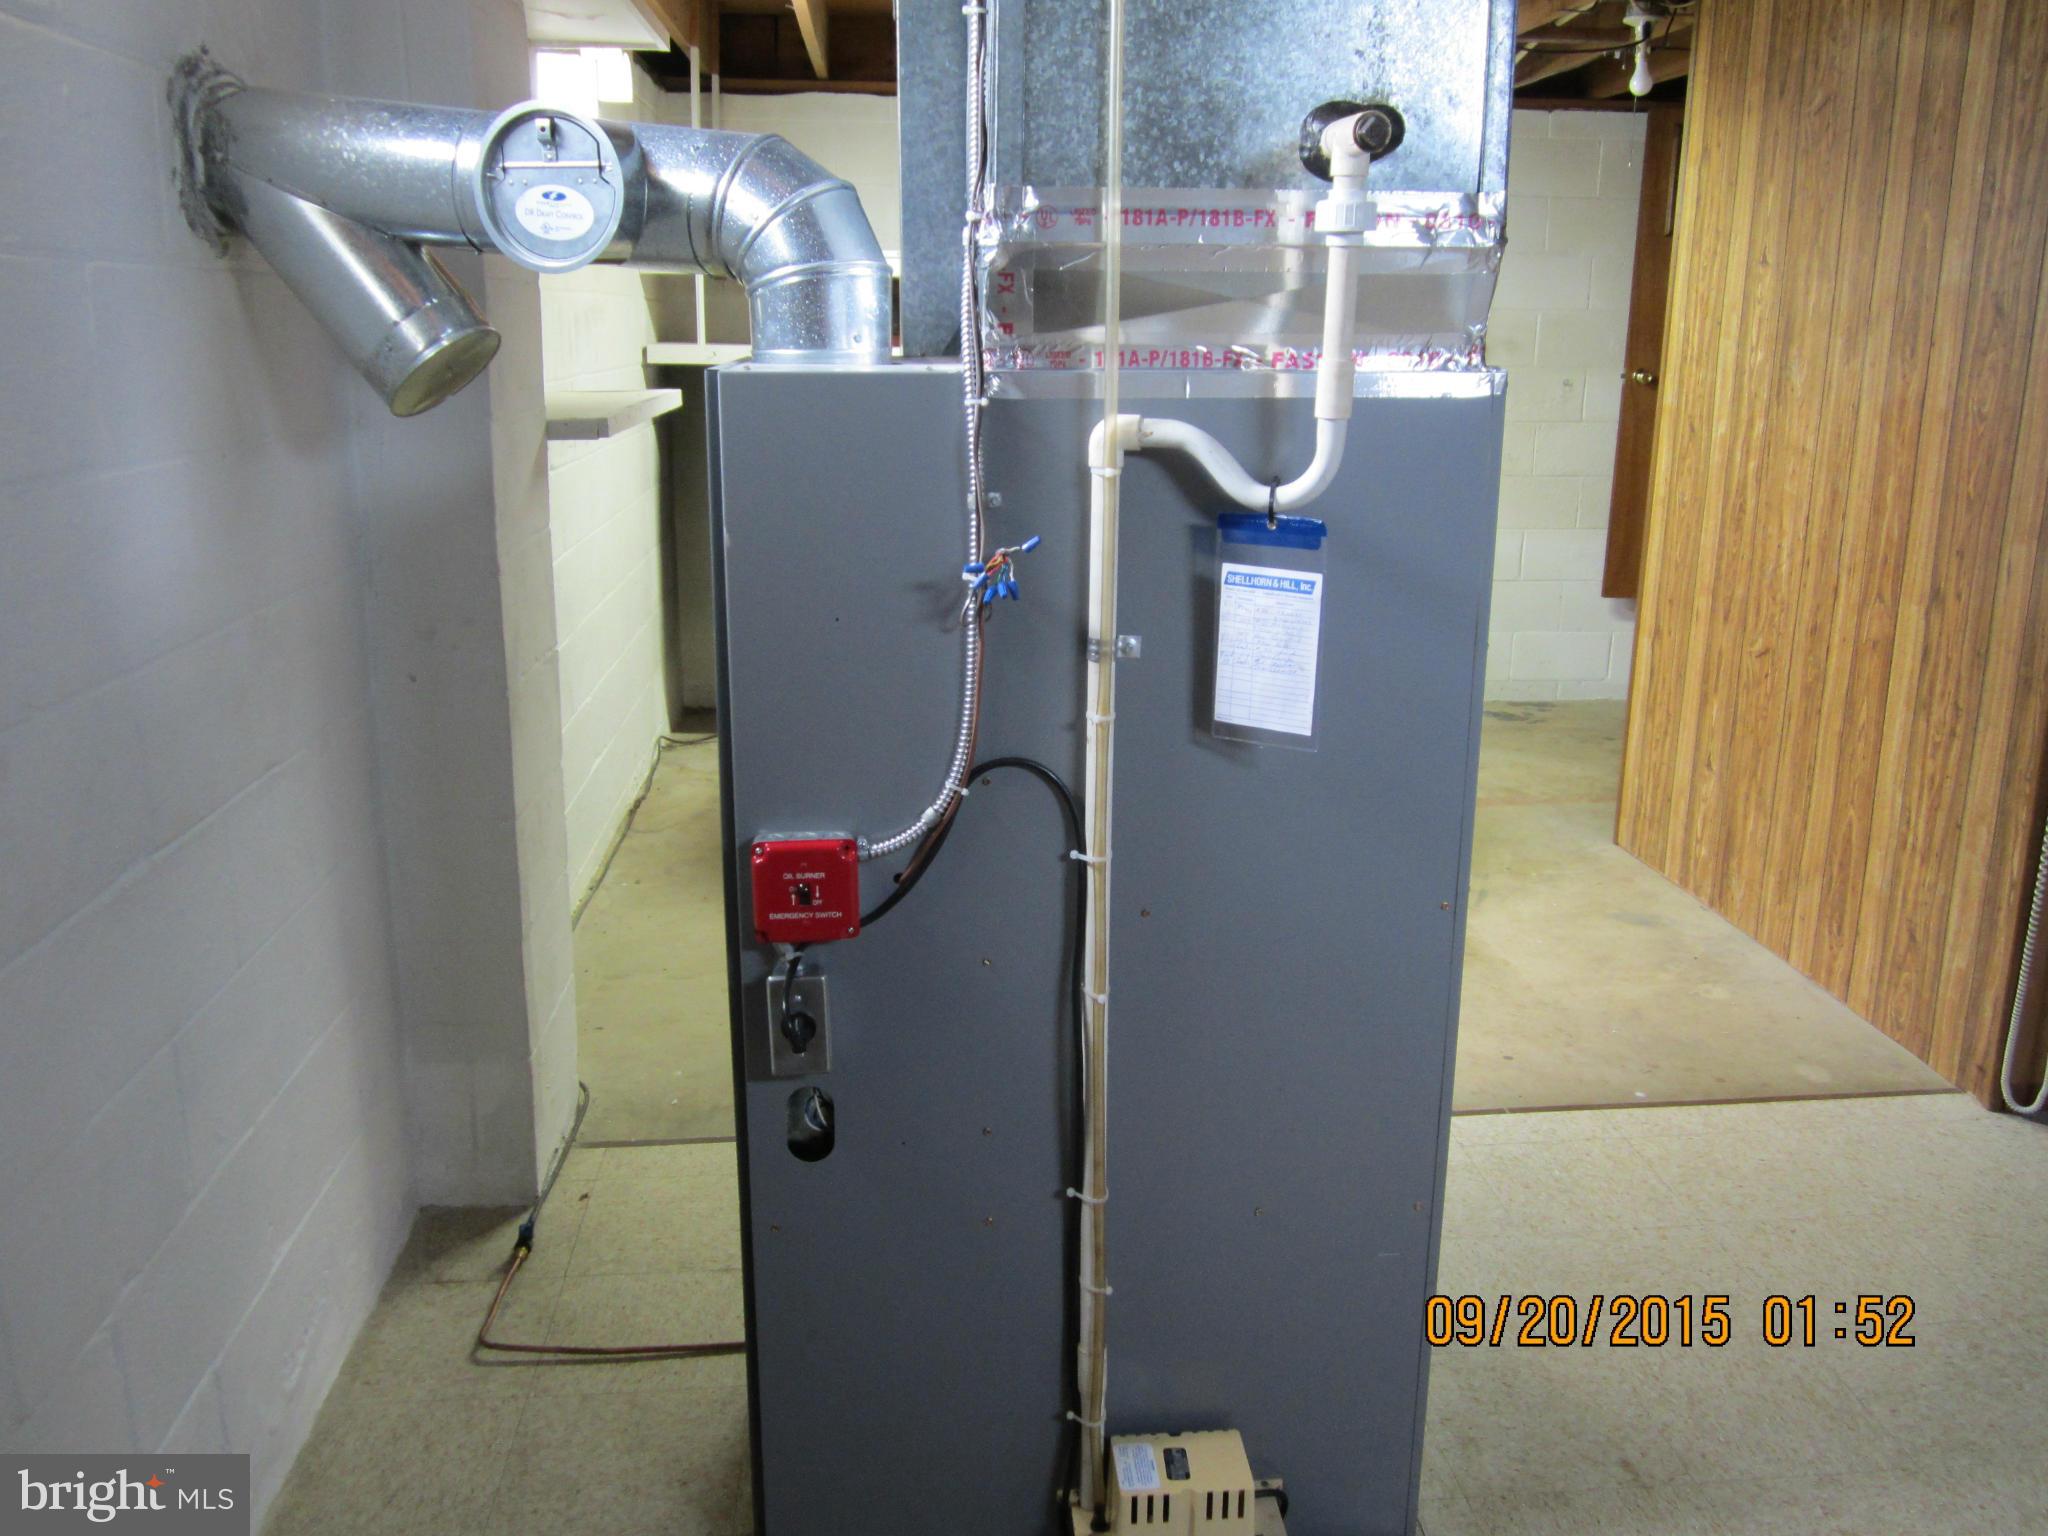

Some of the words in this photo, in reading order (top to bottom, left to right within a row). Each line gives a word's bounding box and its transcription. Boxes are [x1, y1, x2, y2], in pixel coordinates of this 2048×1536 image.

[1121, 207, 1276, 228] 181A-P/181B-FX
[1096, 350, 1242, 369] 11A-P/181B-FX
[1227, 573, 1272, 587] SHELLHORN
[1272, 579, 1279, 588] &
[796, 872, 825, 880] BURNER
[769, 912, 813, 920] EMERGENCY
[815, 911, 842, 919] SWITCH
